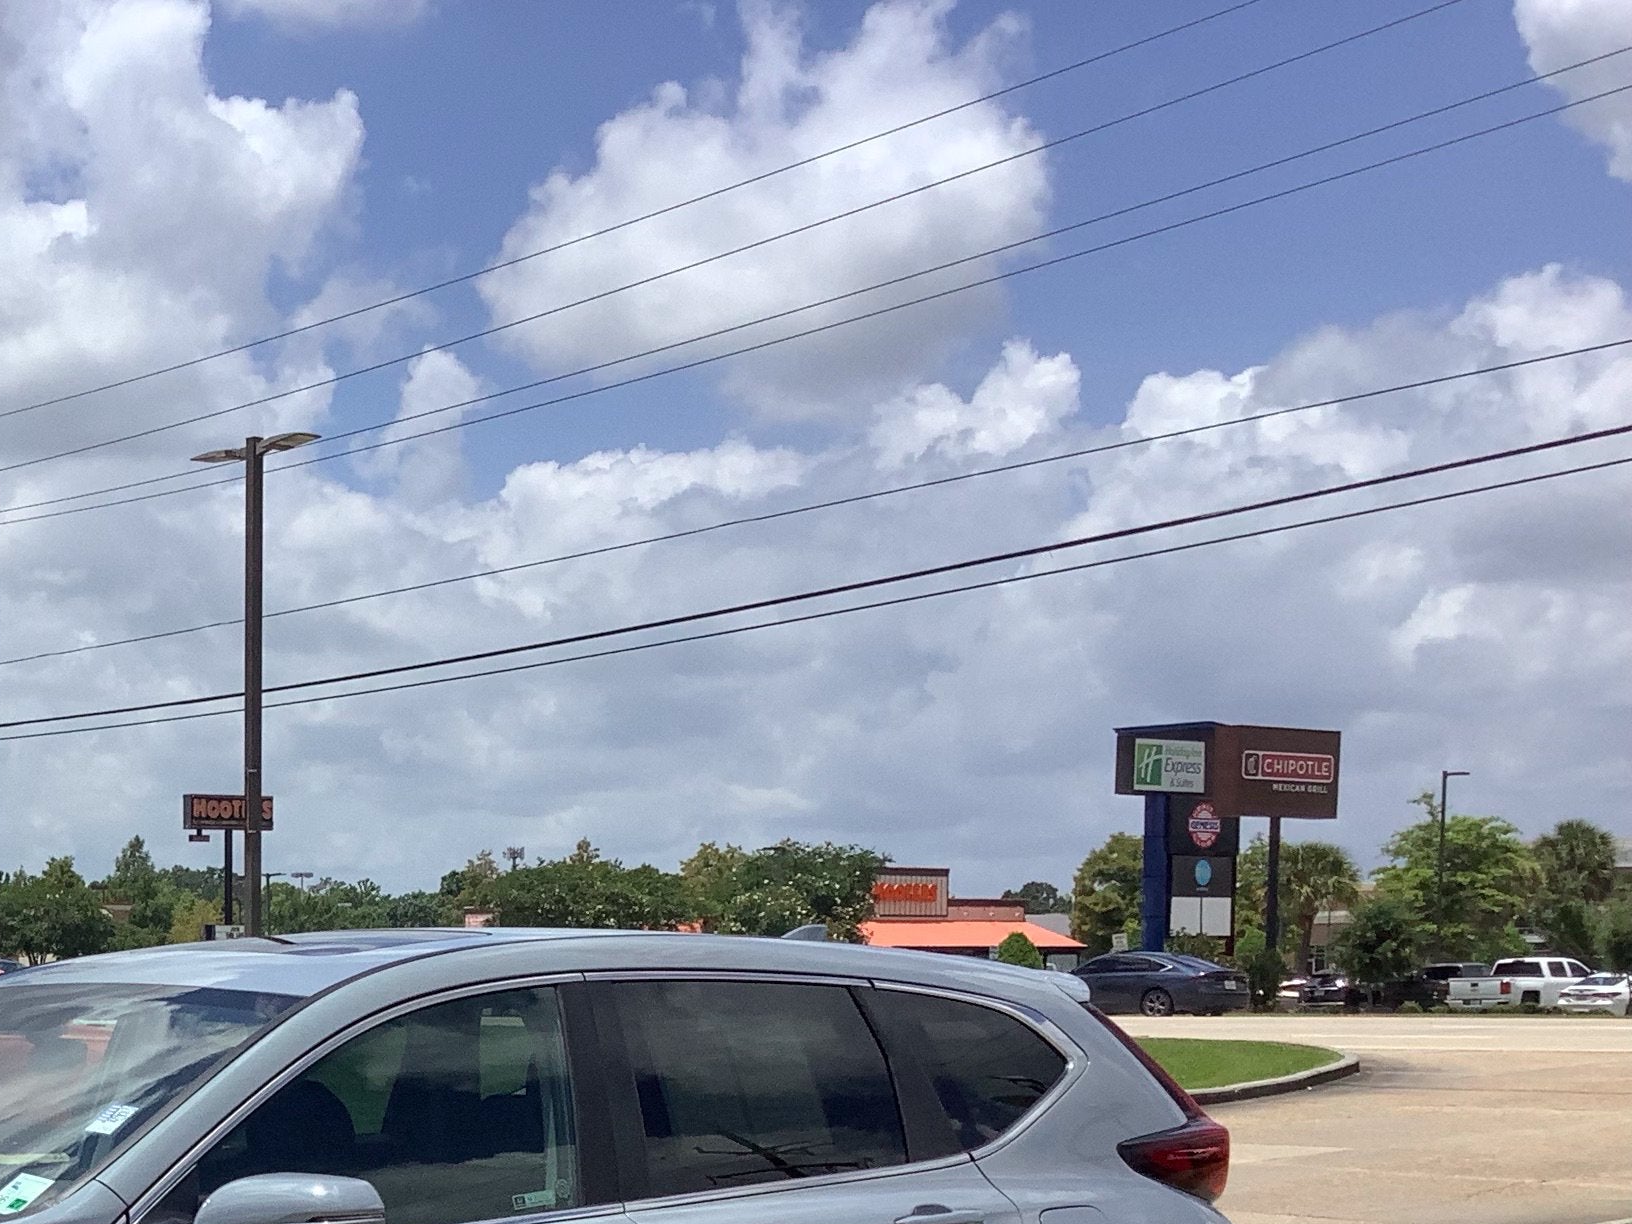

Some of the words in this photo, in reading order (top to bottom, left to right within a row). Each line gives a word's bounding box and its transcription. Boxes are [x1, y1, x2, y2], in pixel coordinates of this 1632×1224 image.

[1164, 757, 1202, 776] Express
[1263, 758, 1330, 776] CHIPOTLE
[1272, 783, 1305, 793] MEXICAN
